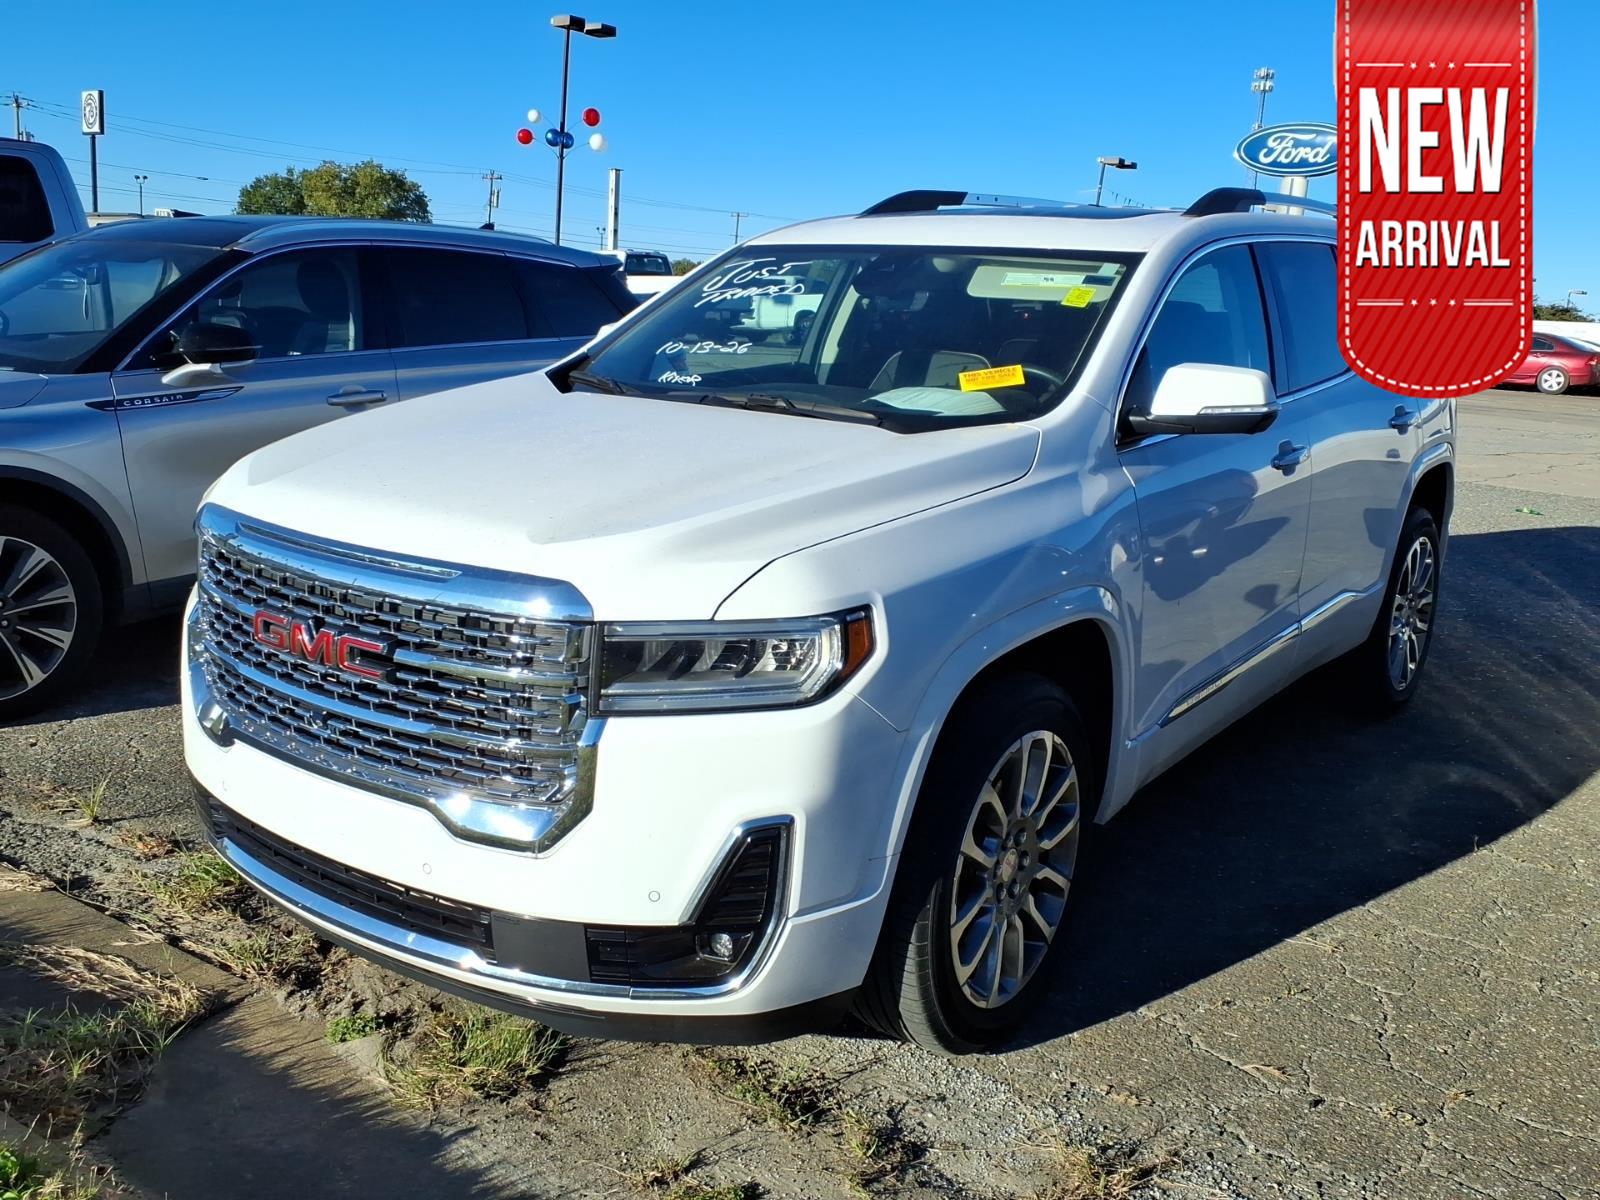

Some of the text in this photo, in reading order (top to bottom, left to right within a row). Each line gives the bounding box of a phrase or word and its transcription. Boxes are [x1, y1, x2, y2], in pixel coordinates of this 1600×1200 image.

[1258, 132, 1337, 164] Ford
[702, 257, 814, 292] JUST
[656, 341, 753, 355] 10-13-26
[122, 394, 184, 407] CORSAIR
[253, 609, 389, 679] GMC
